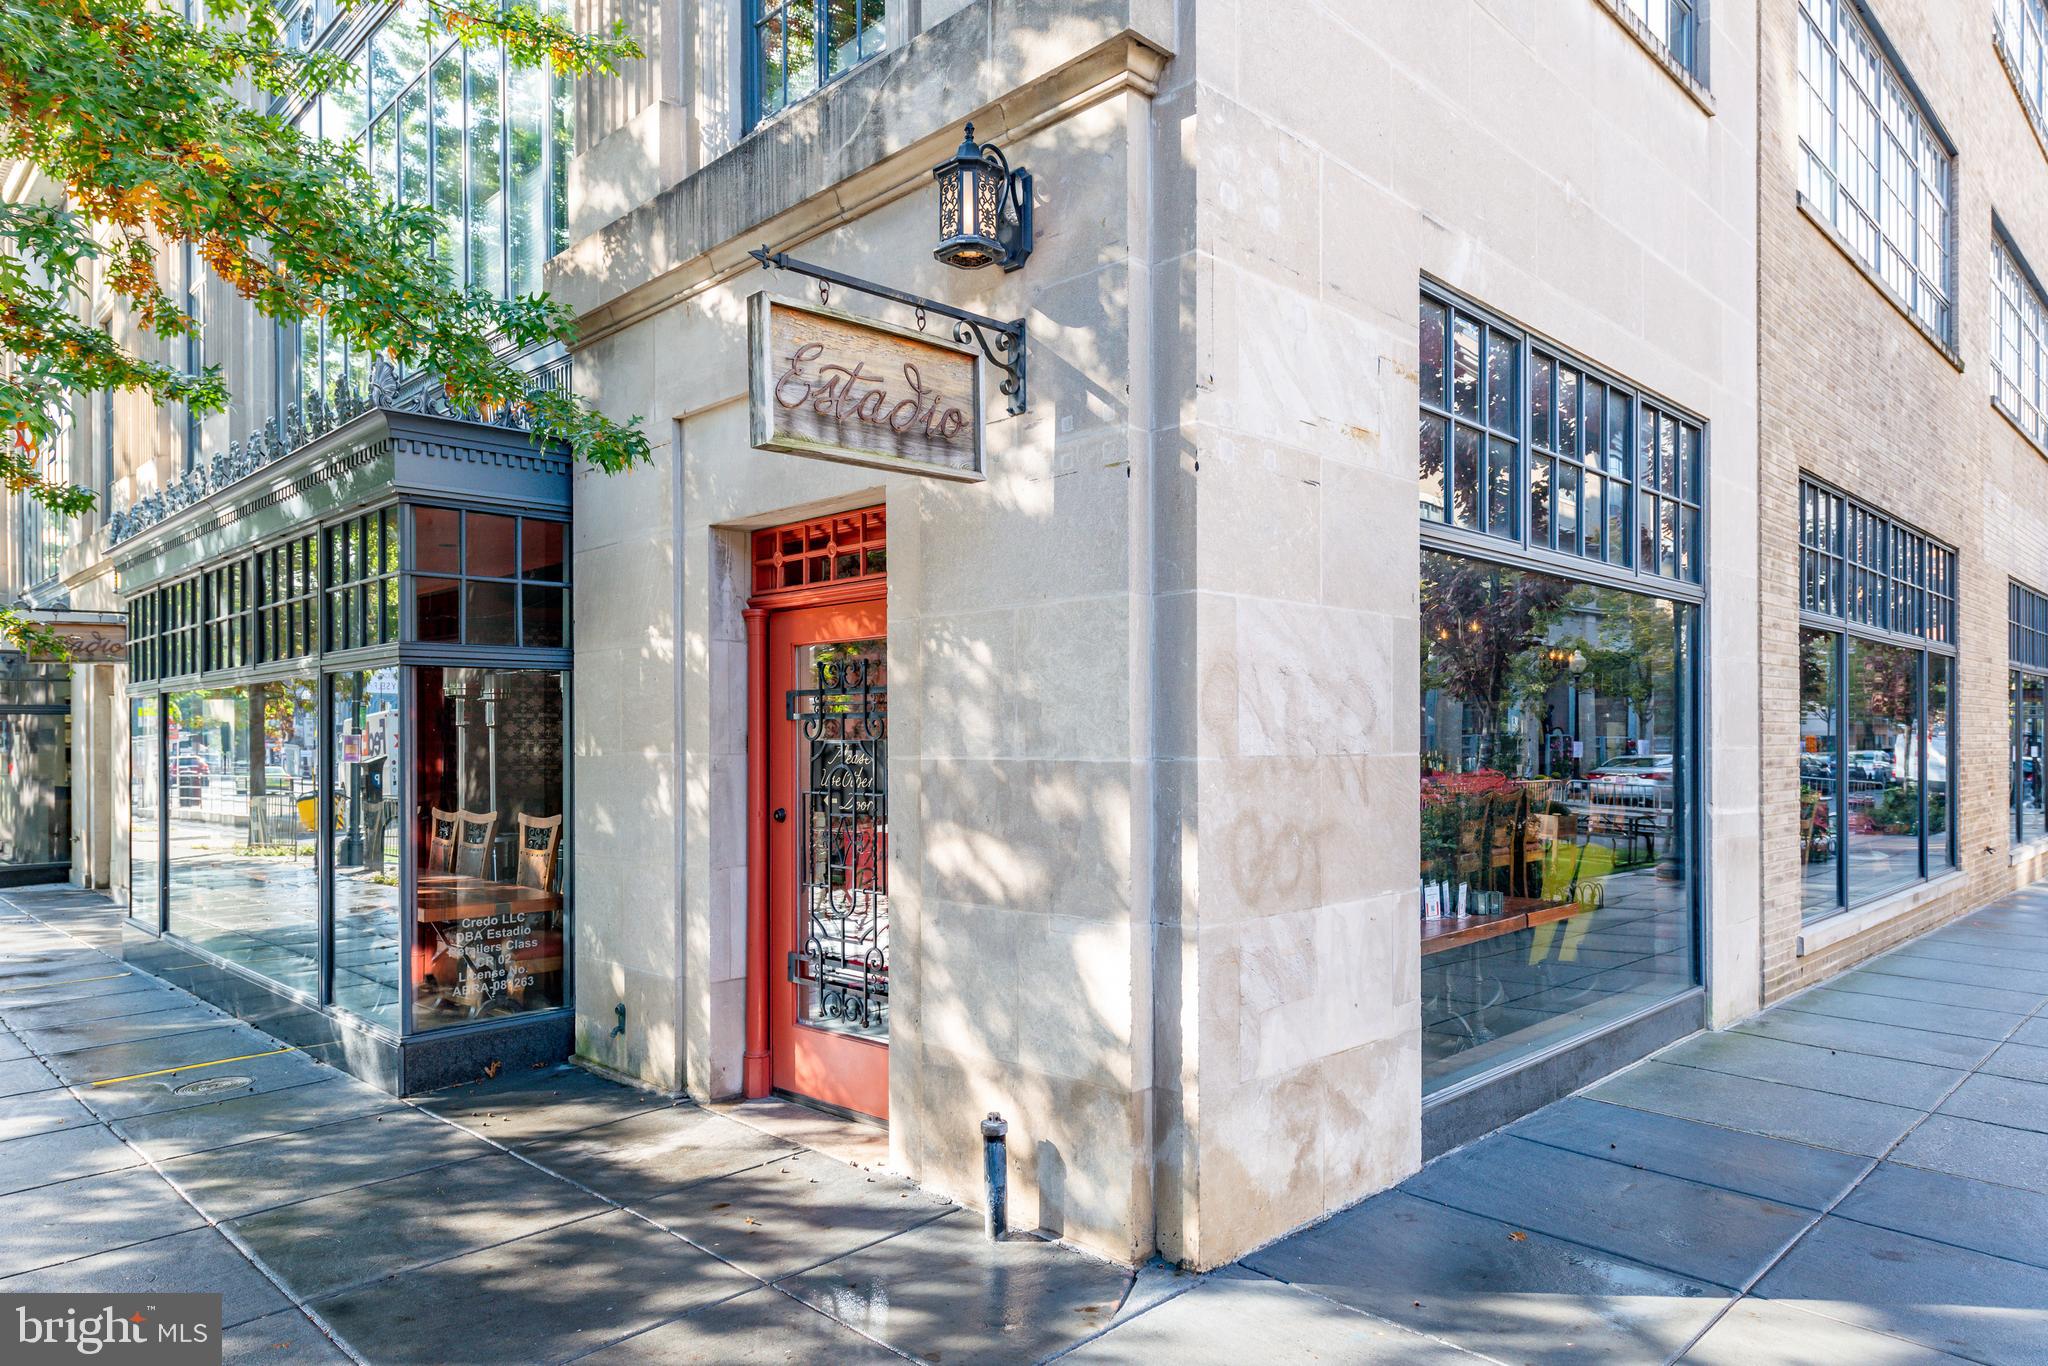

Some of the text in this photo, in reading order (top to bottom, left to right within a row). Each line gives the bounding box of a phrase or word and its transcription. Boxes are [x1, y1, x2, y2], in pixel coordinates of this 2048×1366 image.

[776, 342, 969, 438] Estadio
[56, 631, 124, 653] adio
[828, 744, 871, 764] Please
[821, 766, 873, 788] Use Other
[461, 912, 526, 928] Credo LLC
[456, 925, 531, 942] DBA Estadio
[506, 939, 538, 950] Class
[498, 954, 512, 965] 02
[459, 965, 528, 982] Lcense No.
